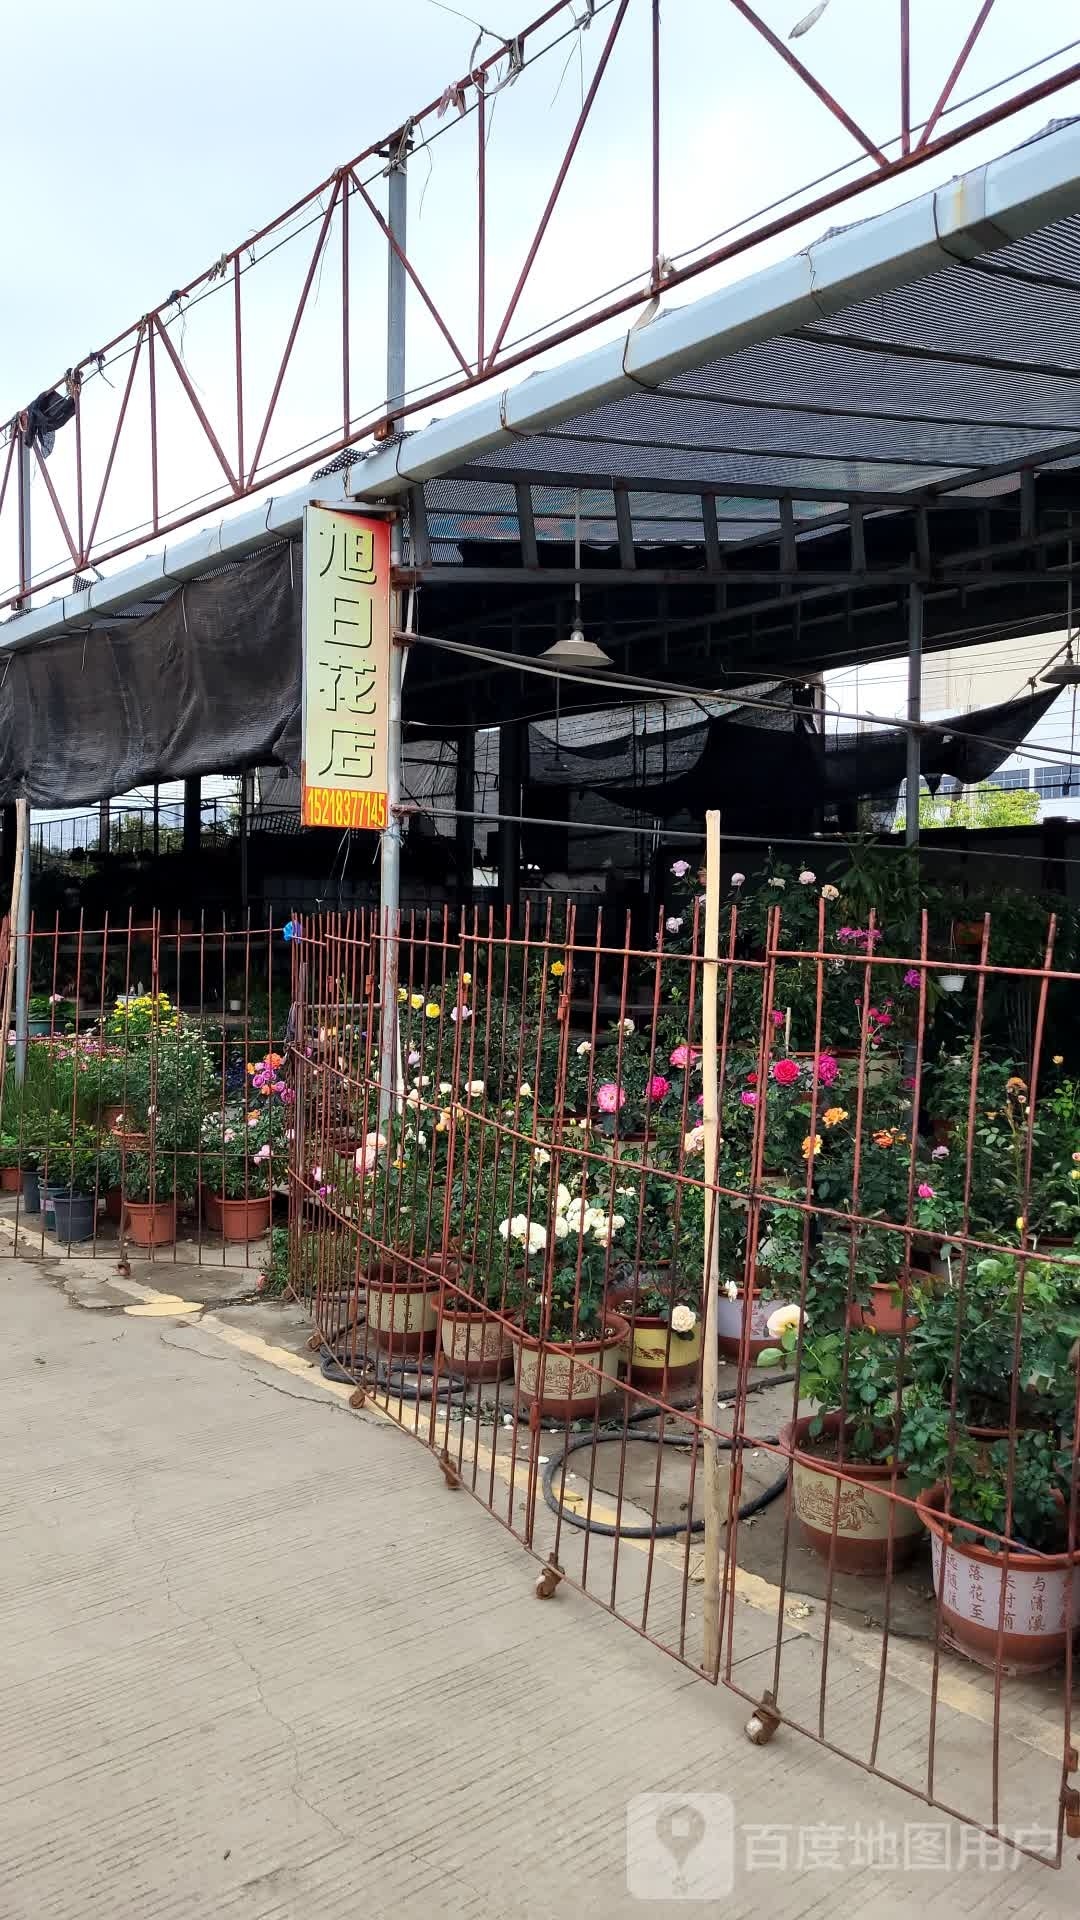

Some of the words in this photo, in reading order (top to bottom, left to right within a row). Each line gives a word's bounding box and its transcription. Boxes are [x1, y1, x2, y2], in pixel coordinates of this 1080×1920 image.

[318, 521, 377, 778] 旭日花店
[308, 788, 385, 828] 15218377145
